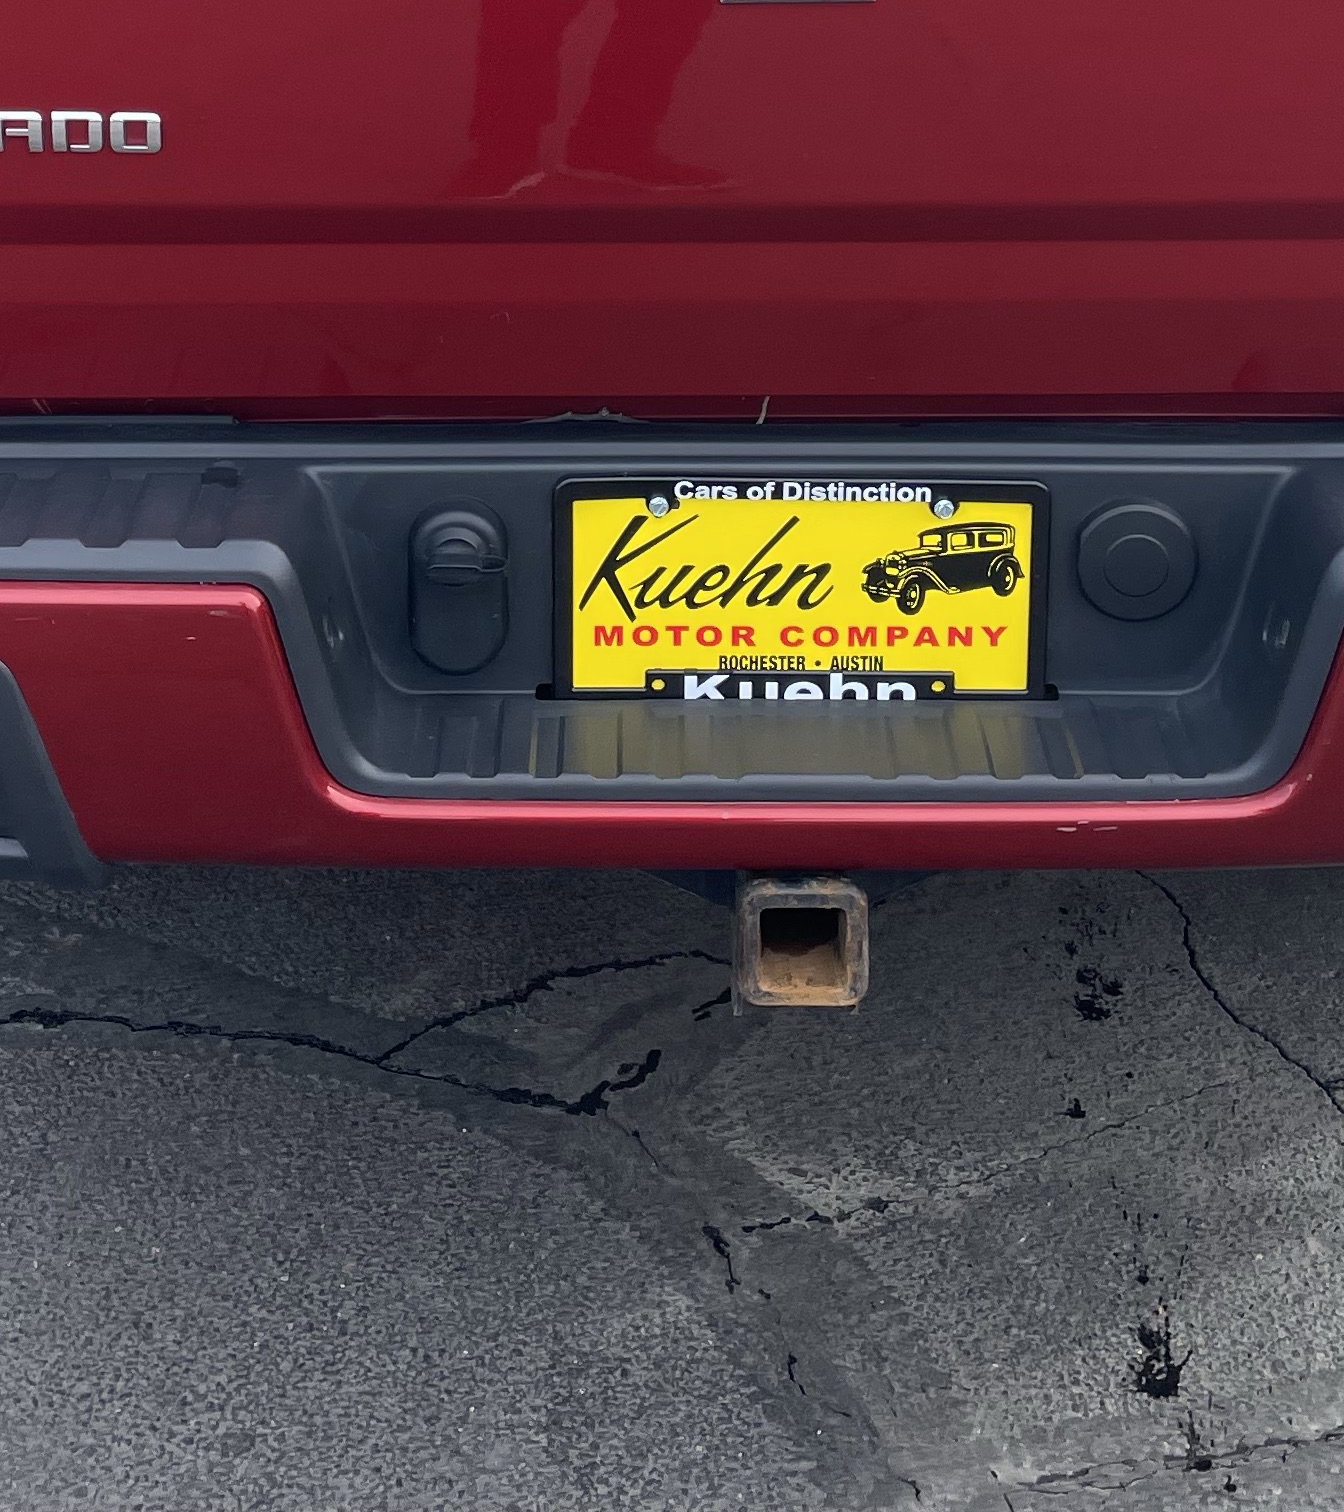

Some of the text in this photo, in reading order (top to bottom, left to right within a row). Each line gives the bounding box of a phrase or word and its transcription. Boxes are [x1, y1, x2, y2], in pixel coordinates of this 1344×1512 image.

[674, 480, 932, 504] Cars of Distinction
[578, 514, 835, 623] Kuehn
[593, 624, 1009, 648] MOTOR COMPANY
[718, 655, 884, 672] ROCHESTER AUSTIN
